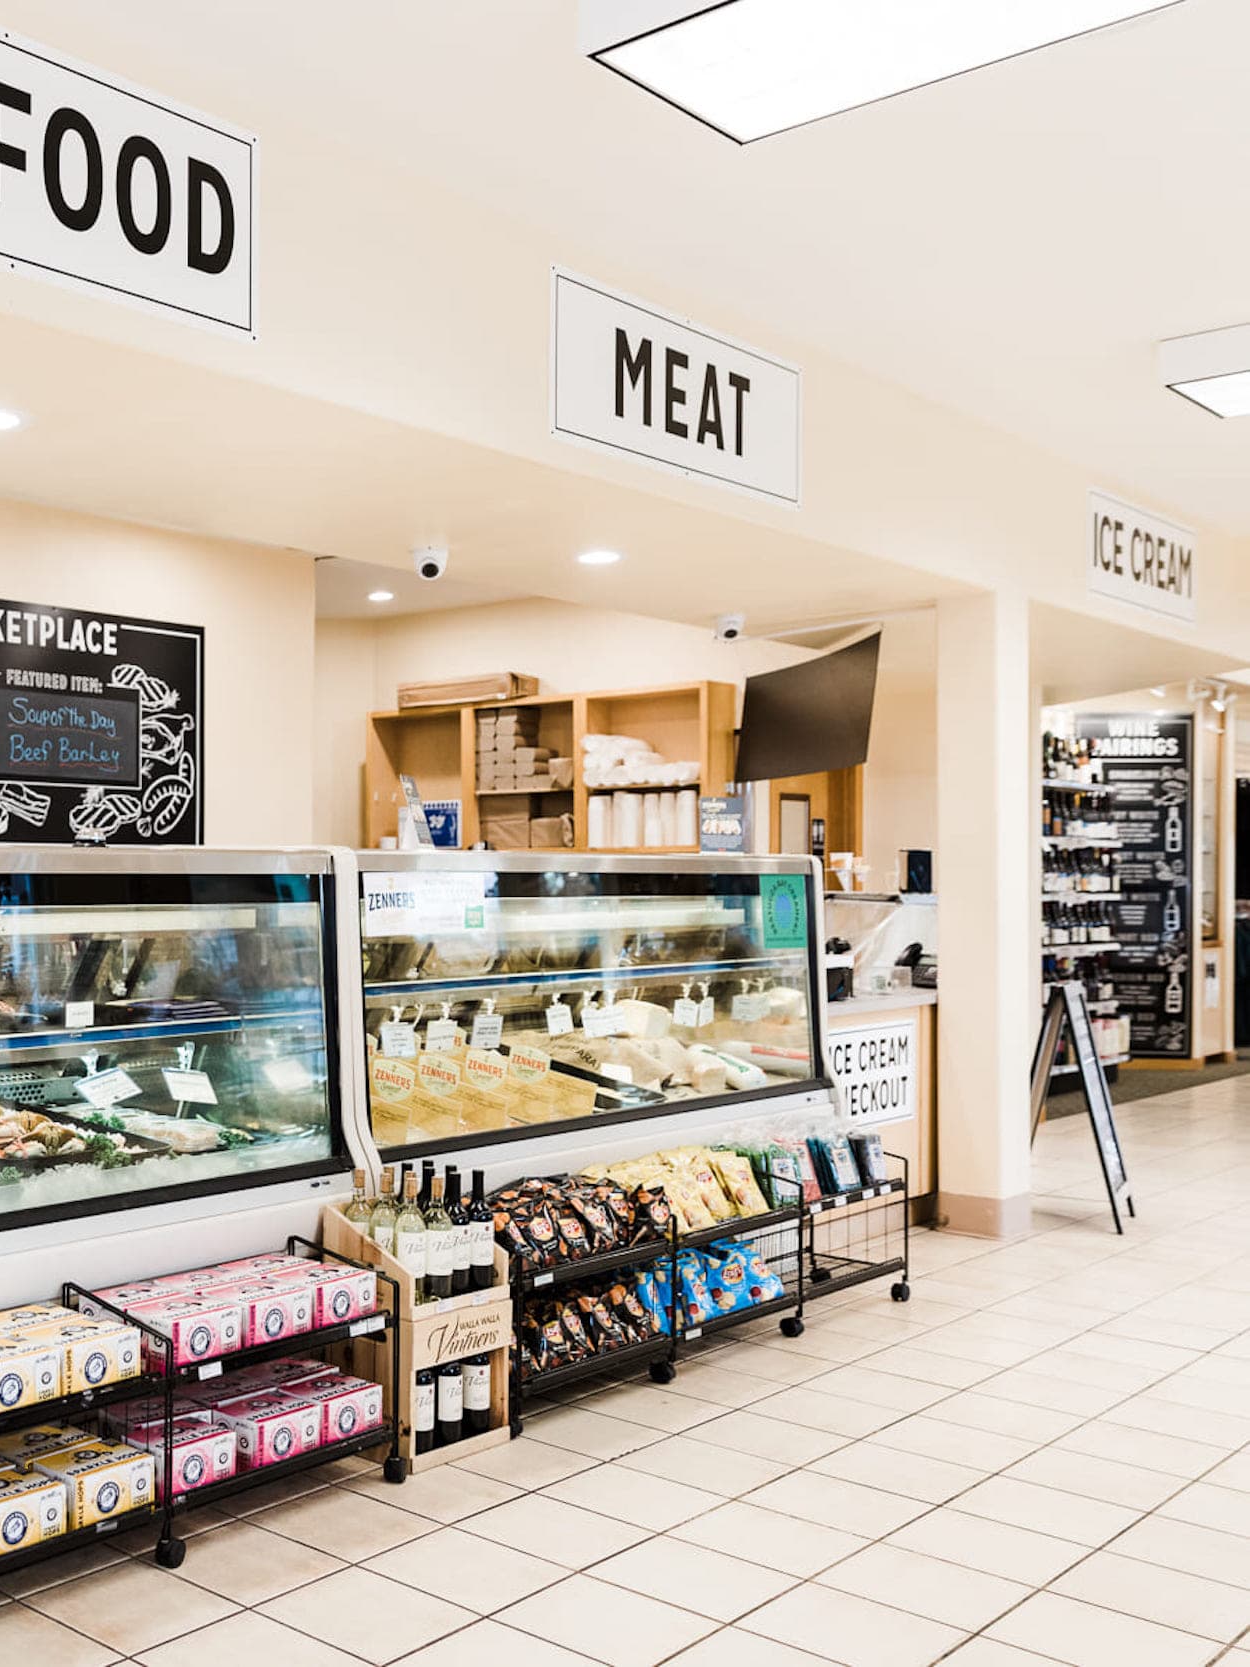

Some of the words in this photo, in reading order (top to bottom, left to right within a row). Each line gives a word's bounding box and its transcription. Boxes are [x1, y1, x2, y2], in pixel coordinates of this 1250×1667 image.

[614, 327, 750, 457] MEAT
[1093, 511, 1124, 576] ICE
[1130, 526, 1193, 599] CREAM
[5, 668, 69, 691] FEATURED
[70, 676, 103, 694] ITEM:
[90, 710, 116, 737] Day
[1108, 719, 1160, 737] WINE
[10, 734, 53, 762] Beef
[858, 1035, 909, 1071] CREAM
[845, 1075, 908, 1117] ECKOUT
[428, 1315, 498, 1363] Vintners
[66, 1458, 114, 1476] SPARKLE
